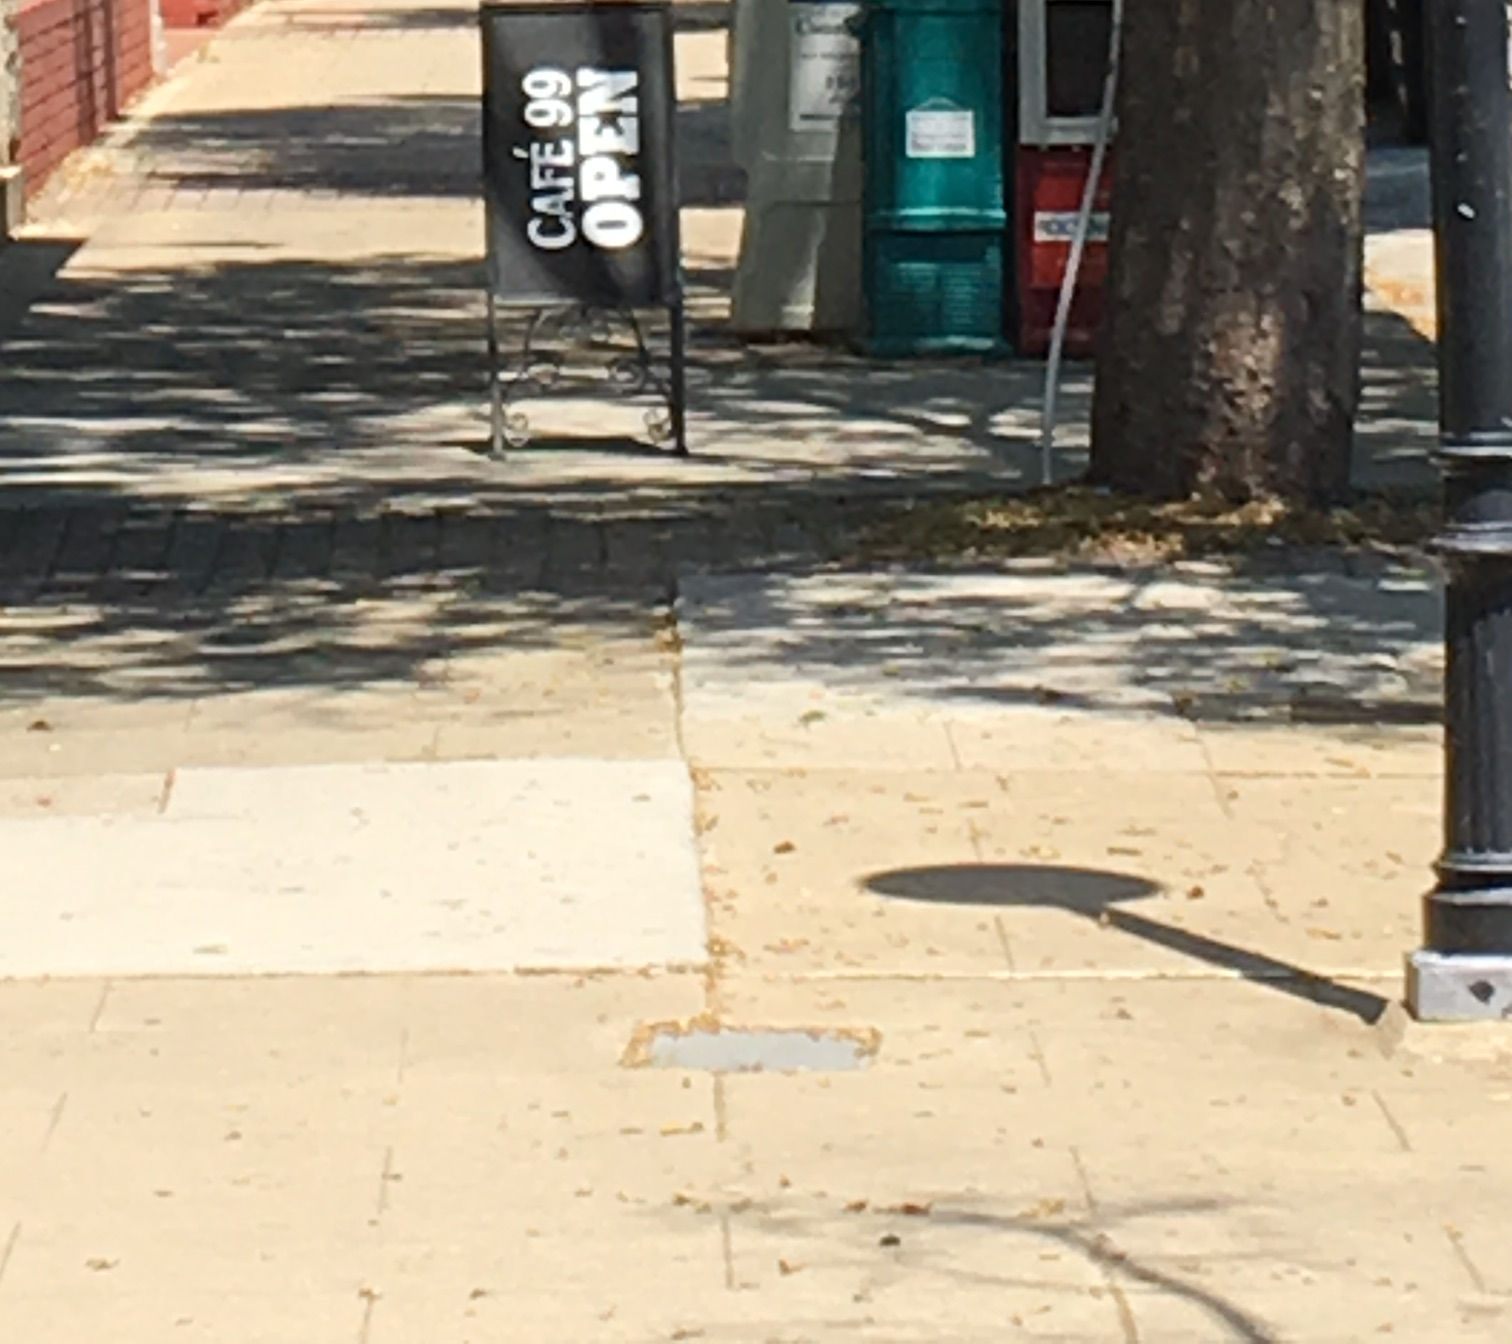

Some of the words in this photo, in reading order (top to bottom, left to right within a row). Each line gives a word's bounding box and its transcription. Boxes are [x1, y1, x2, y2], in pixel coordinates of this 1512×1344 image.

[522, 67, 574, 129] 99
[513, 138, 577, 250] CAFÉ
[577, 67, 643, 250] OPEN
